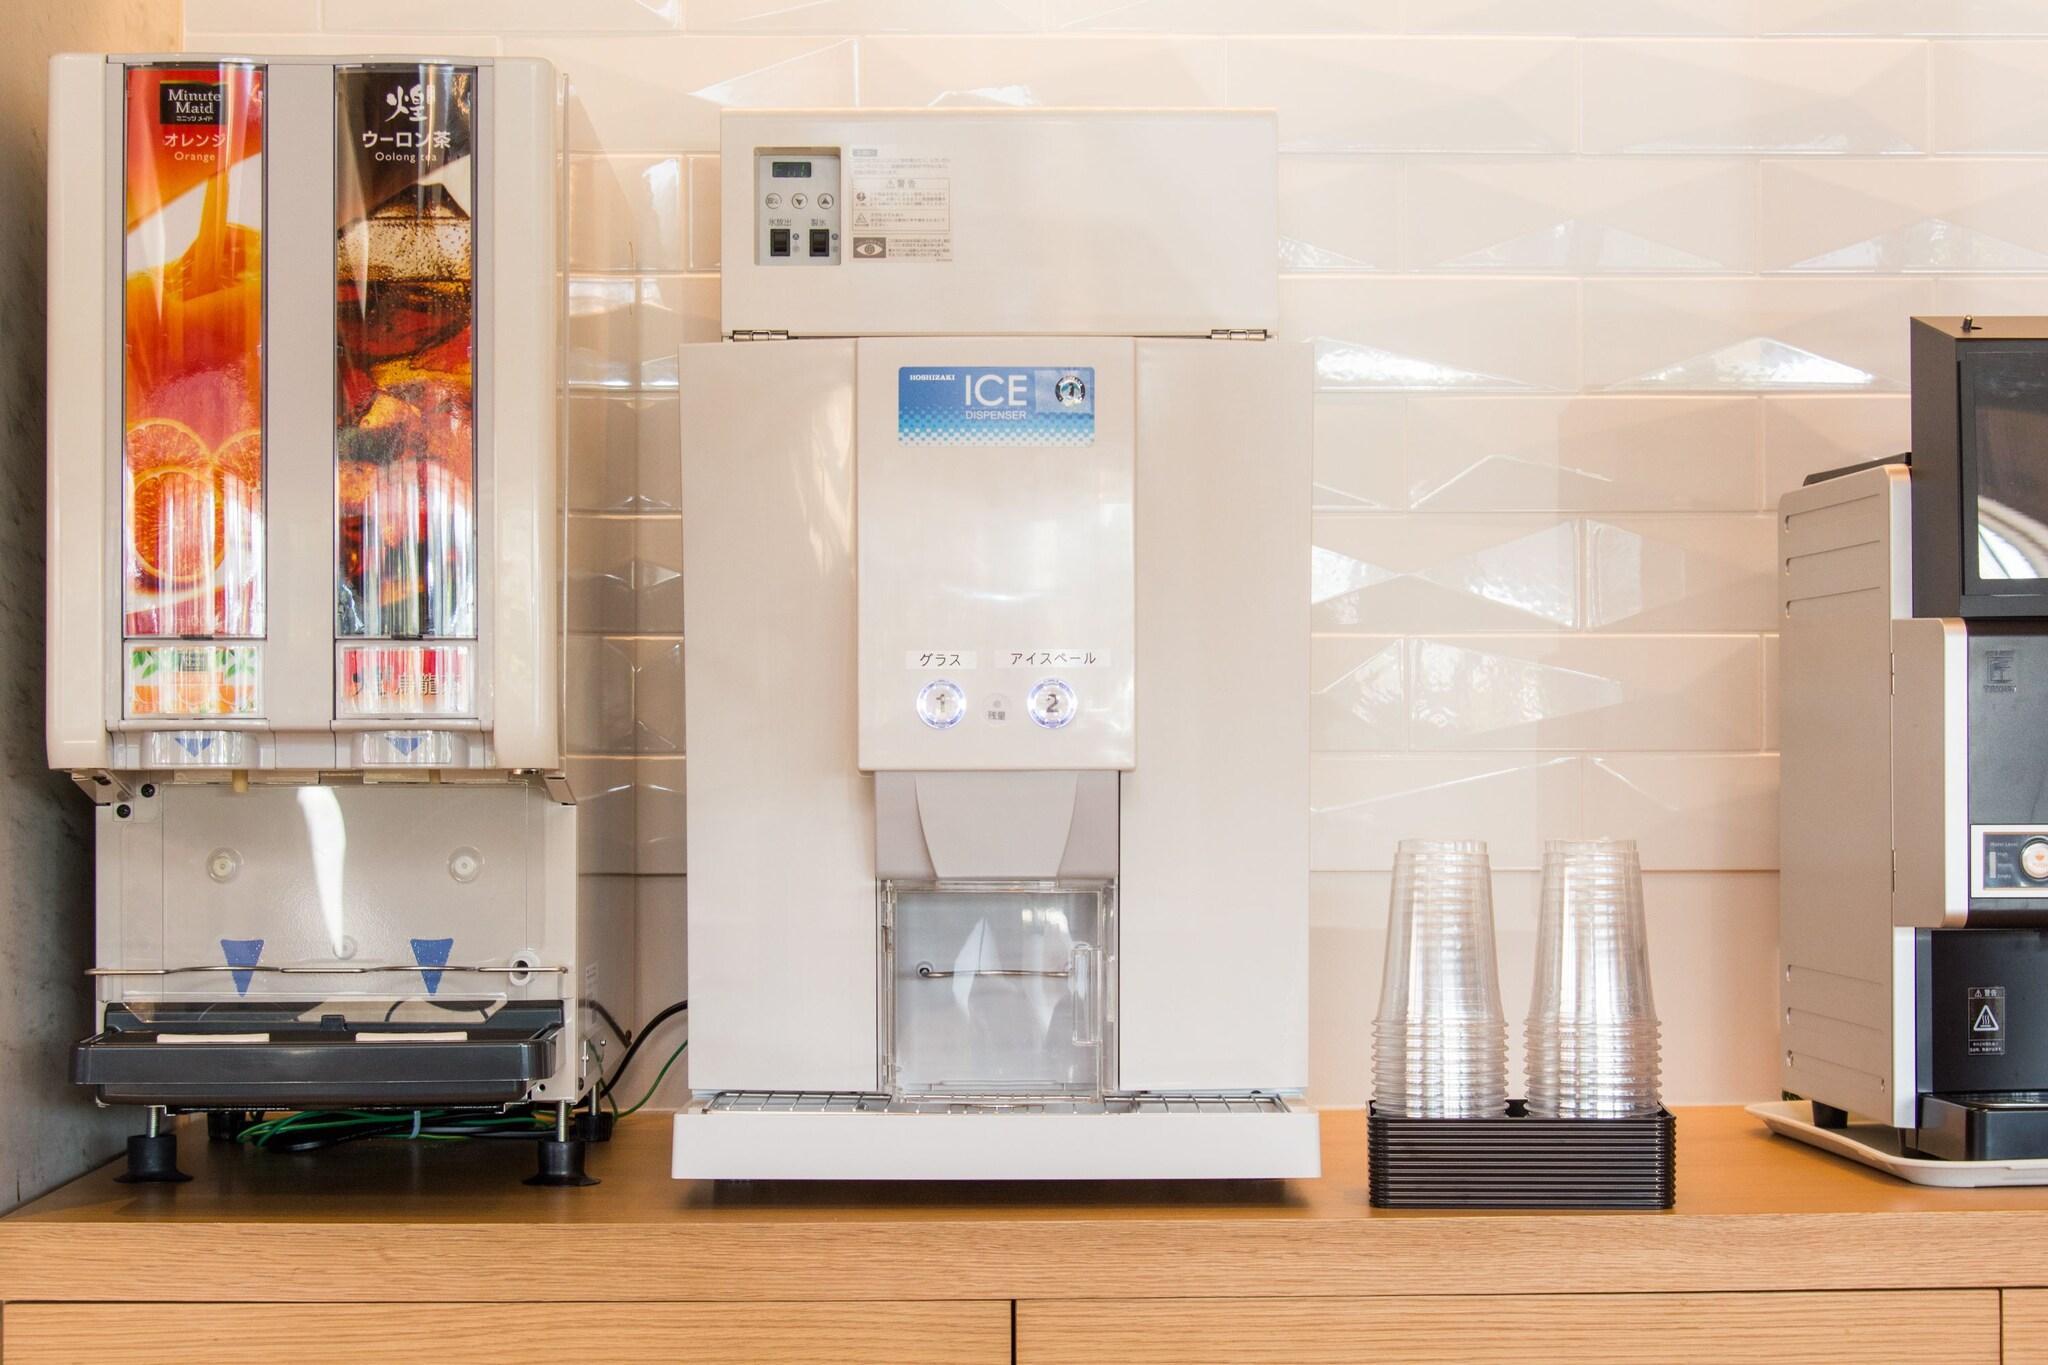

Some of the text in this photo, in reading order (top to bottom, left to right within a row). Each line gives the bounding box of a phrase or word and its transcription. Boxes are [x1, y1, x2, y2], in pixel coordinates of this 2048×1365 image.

[168, 88, 222, 101] Minute
[176, 101, 214, 114] Maid
[162, 132, 226, 148] オレンジ
[362, 130, 451, 149] ウーロン茶
[174, 151, 216, 163] Orange
[375, 152, 416, 163] Oolong
[965, 373, 1028, 407] ICE
[965, 410, 1026, 420] DISPENSER
[919, 653, 961, 667] グラス
[1010, 652, 1097, 666] アイスペール
[936, 693, 945, 712] 1
[1045, 693, 1059, 712] 2
